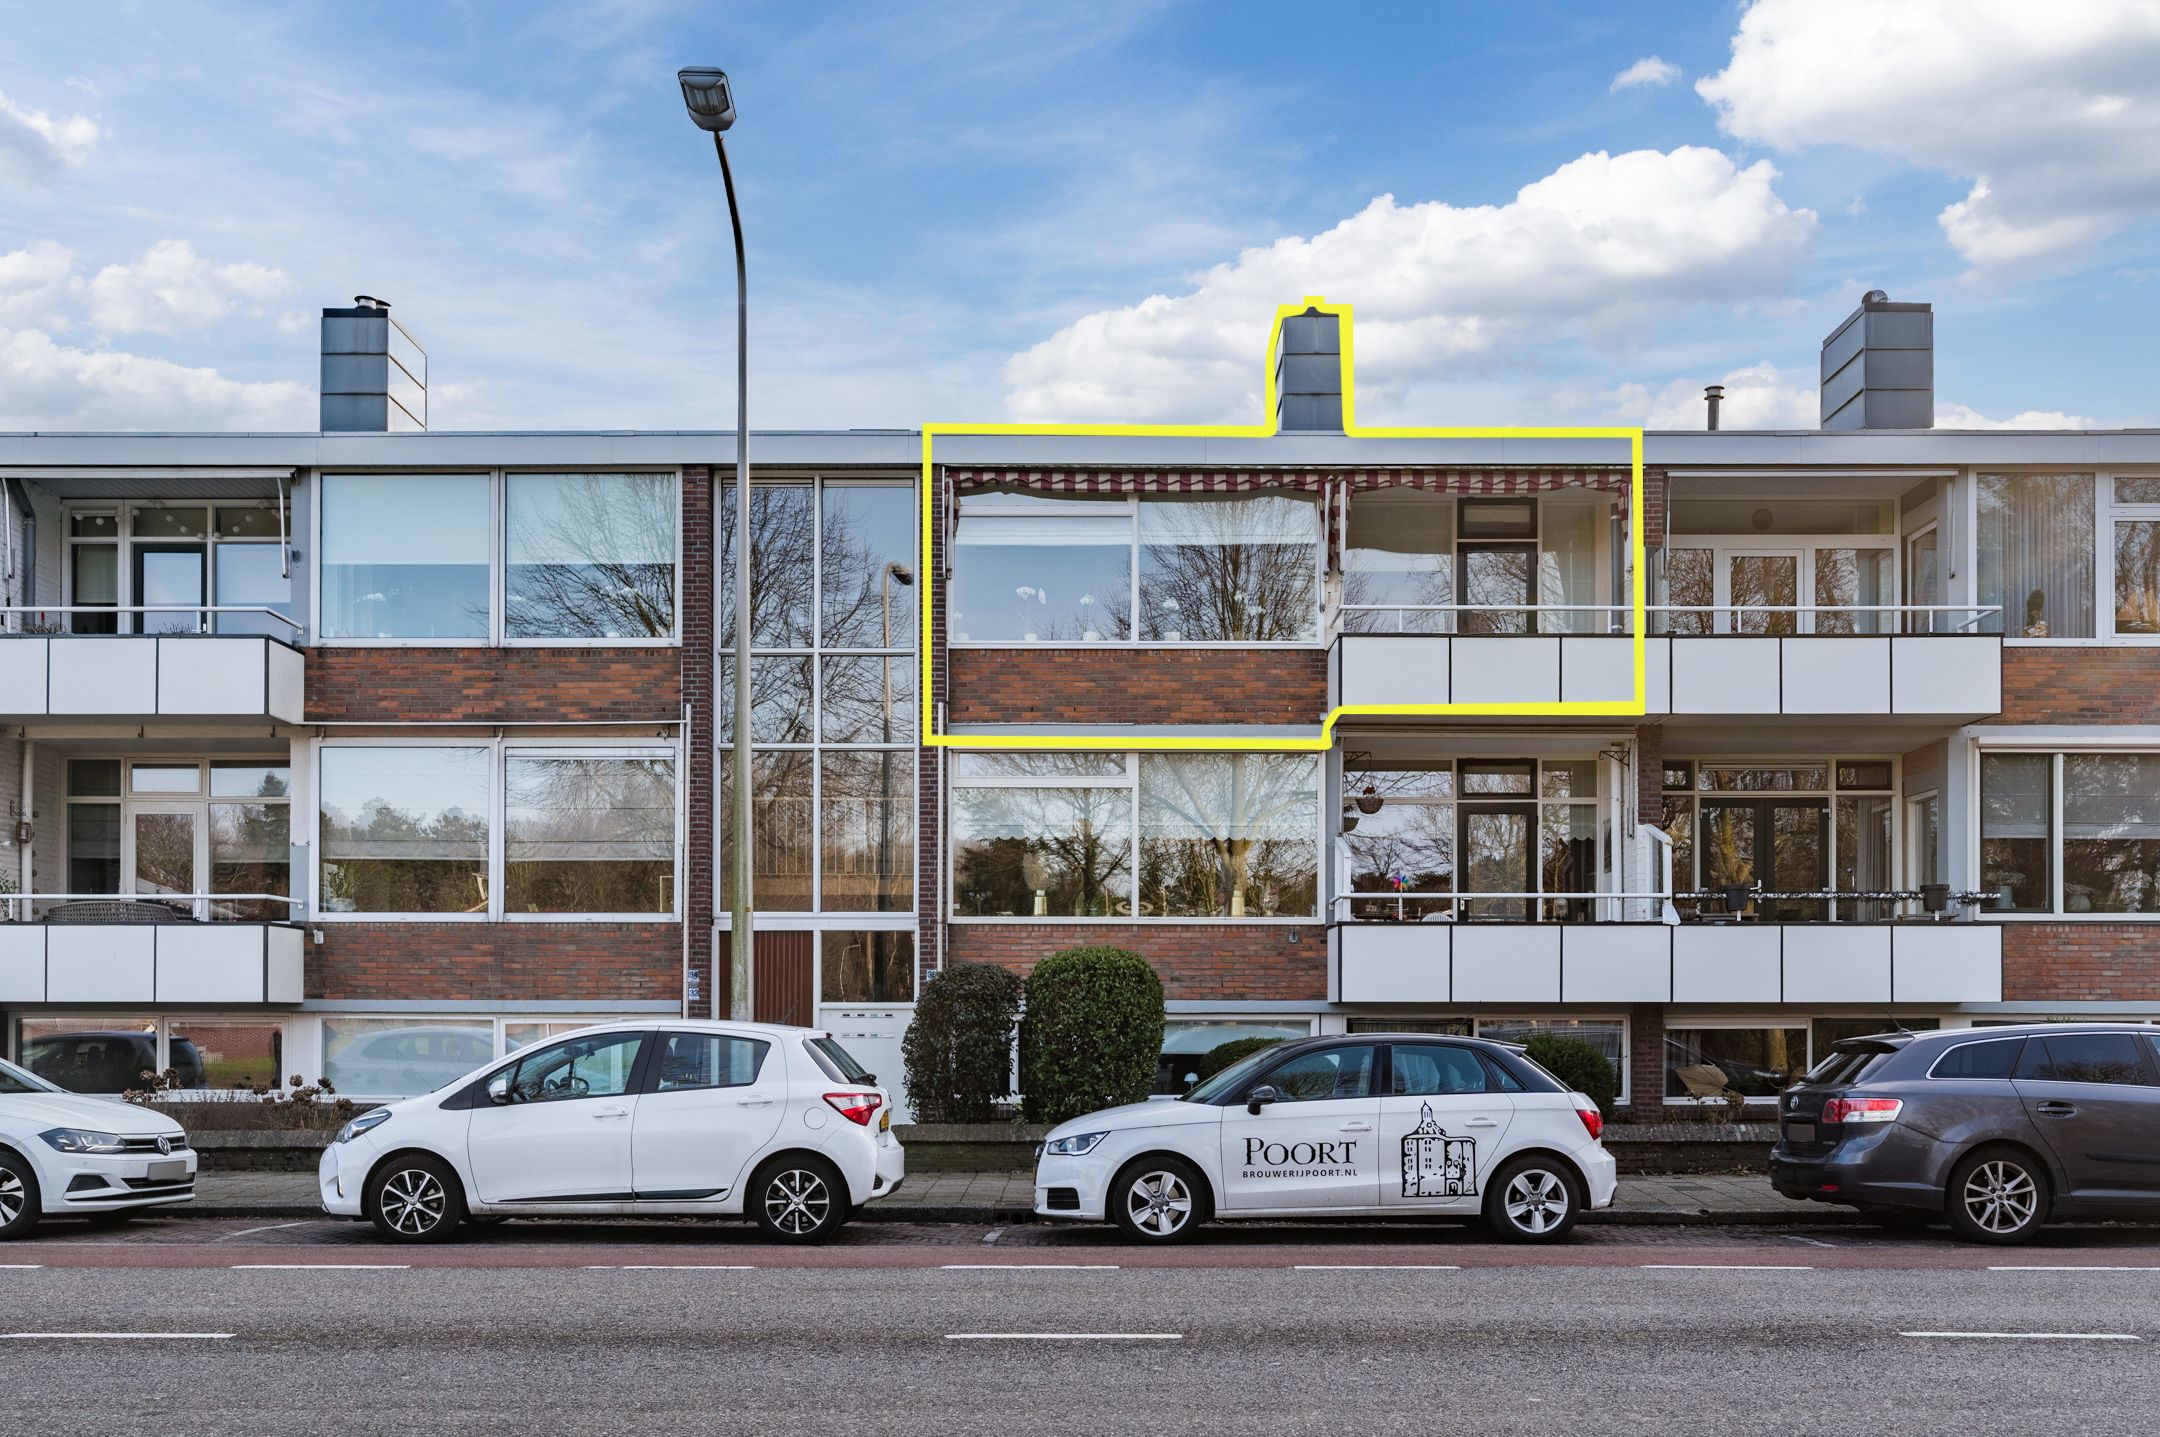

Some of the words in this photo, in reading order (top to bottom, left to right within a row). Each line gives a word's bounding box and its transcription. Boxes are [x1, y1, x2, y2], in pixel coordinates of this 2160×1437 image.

[688, 971, 698, 979] 34
[689, 989, 699, 997] 32
[1242, 1137, 1357, 1166] POORT
[1242, 1169, 1358, 1178] BROUWERIJPOORT.NL
